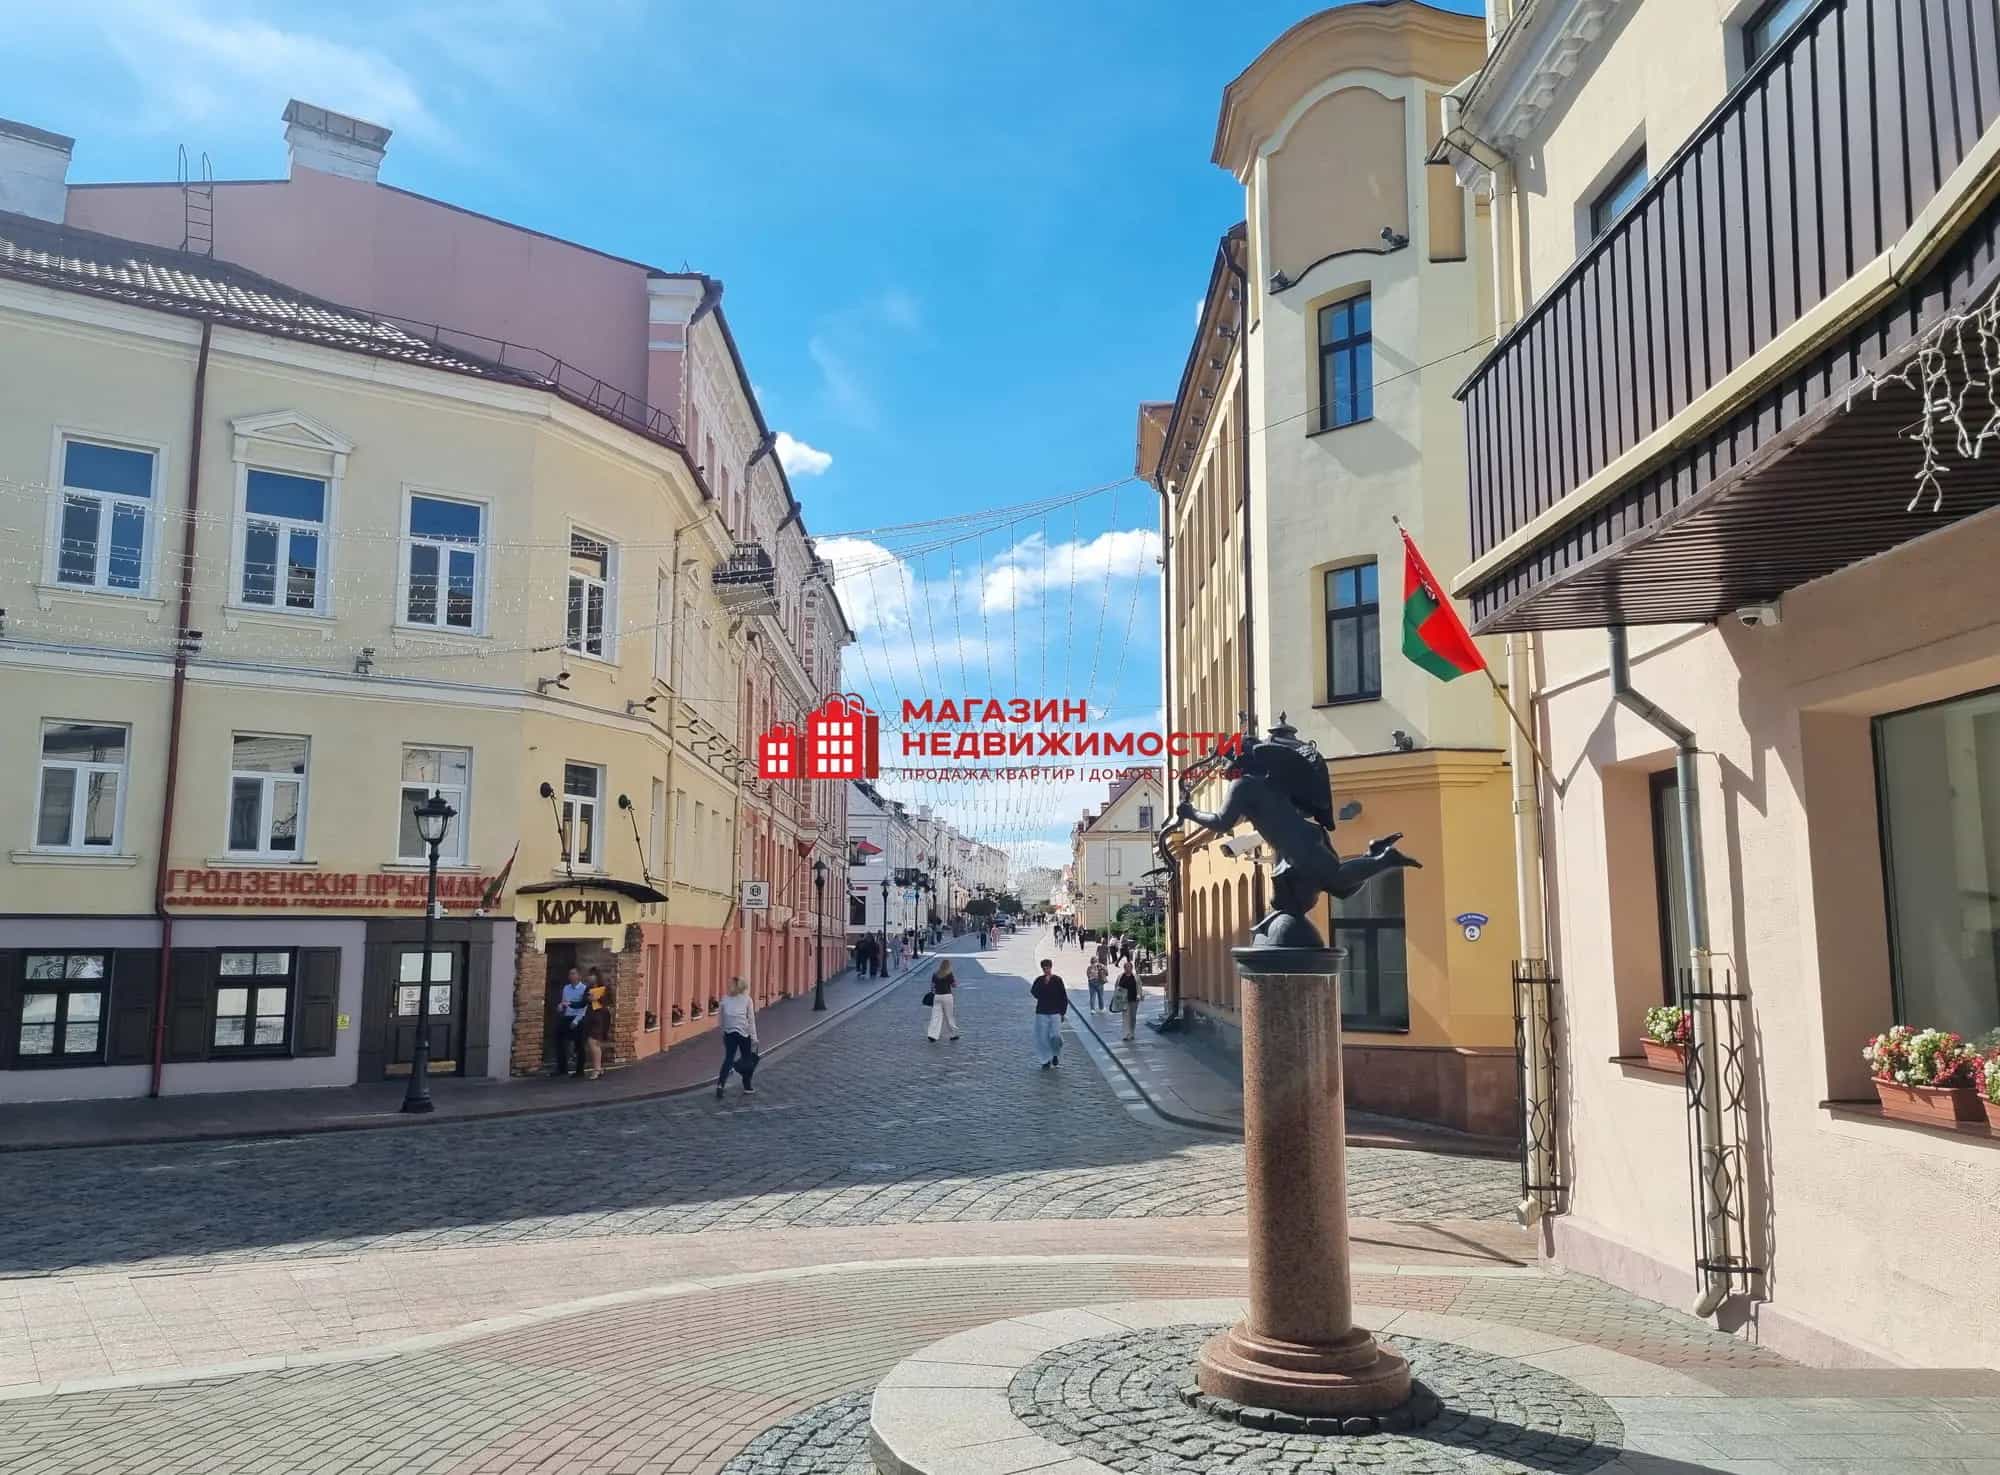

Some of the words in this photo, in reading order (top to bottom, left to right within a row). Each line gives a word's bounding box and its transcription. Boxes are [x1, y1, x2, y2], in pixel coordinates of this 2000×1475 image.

[167, 869, 357, 895] ГРОДЗЕНСКІЯ
[366, 873, 498, 898] ПРЫСМАК
[536, 899, 622, 925] КАРЧМА
